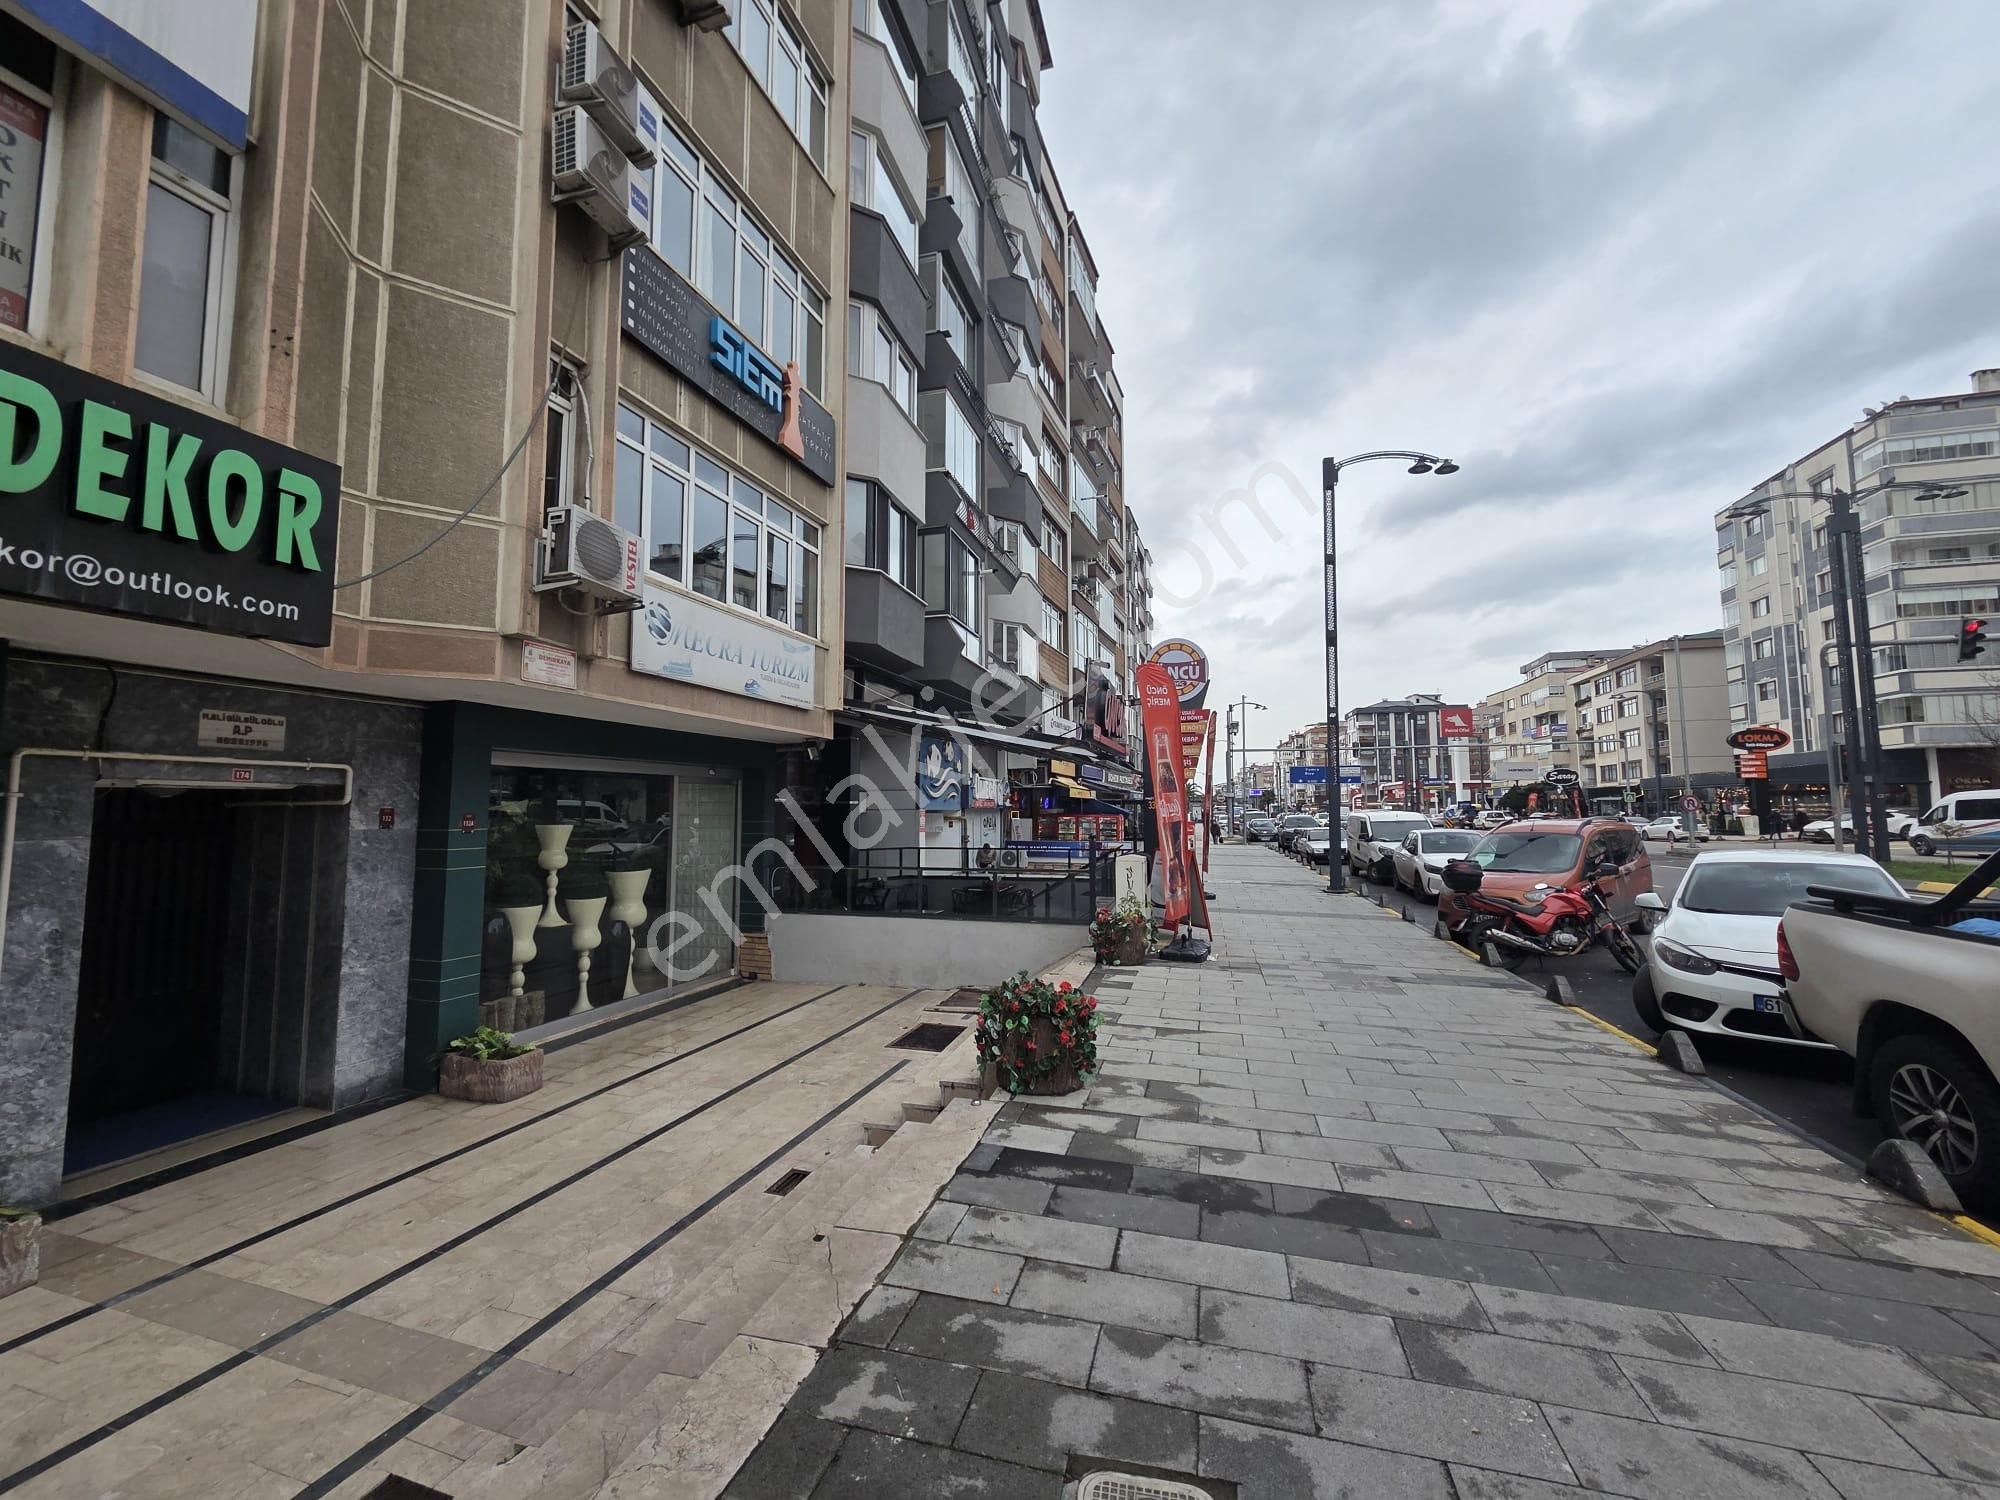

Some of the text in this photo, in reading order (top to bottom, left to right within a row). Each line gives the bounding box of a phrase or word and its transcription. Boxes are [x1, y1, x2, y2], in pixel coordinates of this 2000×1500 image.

[0, 367, 322, 572] DEKOR
[625, 538, 639, 592] VESTEL
[1166, 661, 1200, 681] NCÜ
[1737, 734, 1781, 743] LOKMA
[1765, 999, 1781, 1013] 61
